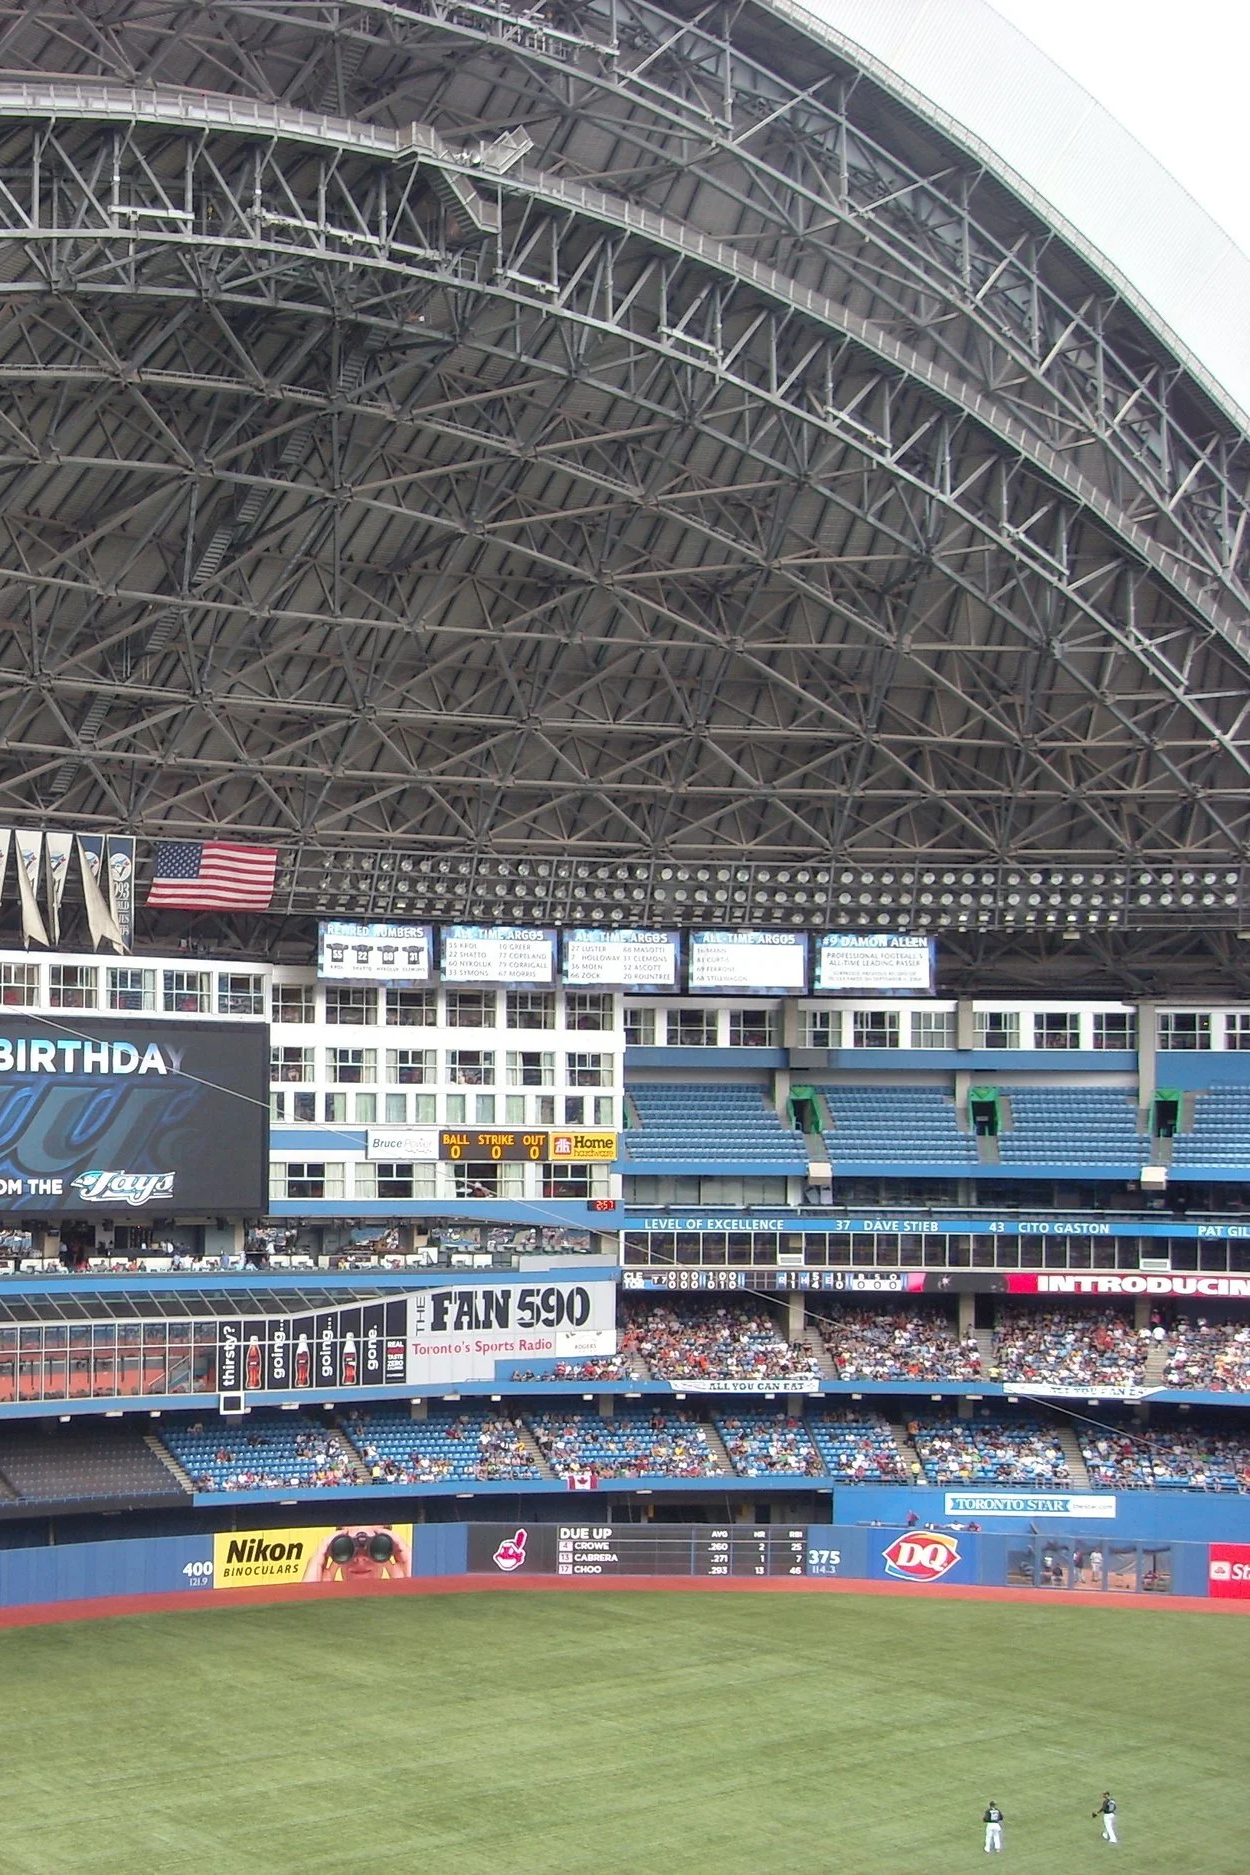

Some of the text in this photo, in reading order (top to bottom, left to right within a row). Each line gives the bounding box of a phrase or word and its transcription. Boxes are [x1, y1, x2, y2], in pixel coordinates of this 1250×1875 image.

[374, 926, 424, 938] NUMBERS
[757, 934, 796, 945] ARGOS
[841, 936, 887, 947] DAMON
[890, 937, 928, 948] ALLEN
[372, 1138, 402, 1149] Bruce
[442, 1134, 546, 1146] BALL STRIKE OUT
[573, 1136, 614, 1150] Home
[451, 1145, 540, 1160] 0 0 0
[27, 1178, 63, 1195] THE
[77, 1170, 176, 1206] Jays
[644, 1219, 682, 1230] LEVEL
[685, 1219, 703, 1230] OF
[707, 1220, 784, 1230] EXCELLENCE
[836, 1220, 850, 1230] 37
[863, 1220, 899, 1231] DAVE
[903, 1220, 939, 1231] STIEB
[989, 1222, 1005, 1232] 43
[1018, 1223, 1049, 1233] CITO
[1054, 1223, 1110, 1234] GASTON
[1197, 1225, 1224, 1236] PAT
[415, 1296, 426, 1336] THE
[431, 1286, 591, 1331] FAN 590
[271, 1318, 286, 1379] going...
[319, 1316, 334, 1377] going...
[367, 1324, 379, 1371] gone.
[412, 1338, 553, 1356] Toronto's Sports Radio
[222, 1325, 236, 1387] thirsty?
[709, 1383, 805, 1391] ALL YOU CAN EAT
[956, 1497, 1066, 1511] TORONTO STAR
[560, 1527, 590, 1539] DUE
[592, 1528, 613, 1539] UP
[226, 1538, 303, 1564] Nikon
[574, 1542, 803, 1551] CROWE .260 25
[574, 1553, 729, 1563] CABRERA .271
[808, 1550, 841, 1565] 375
[896, 1542, 946, 1572] DQ
[182, 1561, 213, 1577] 400
[223, 1564, 299, 1578] BINOCULARS
[574, 1565, 602, 1574] CHOO
[812, 1565, 836, 1574] 114.3
